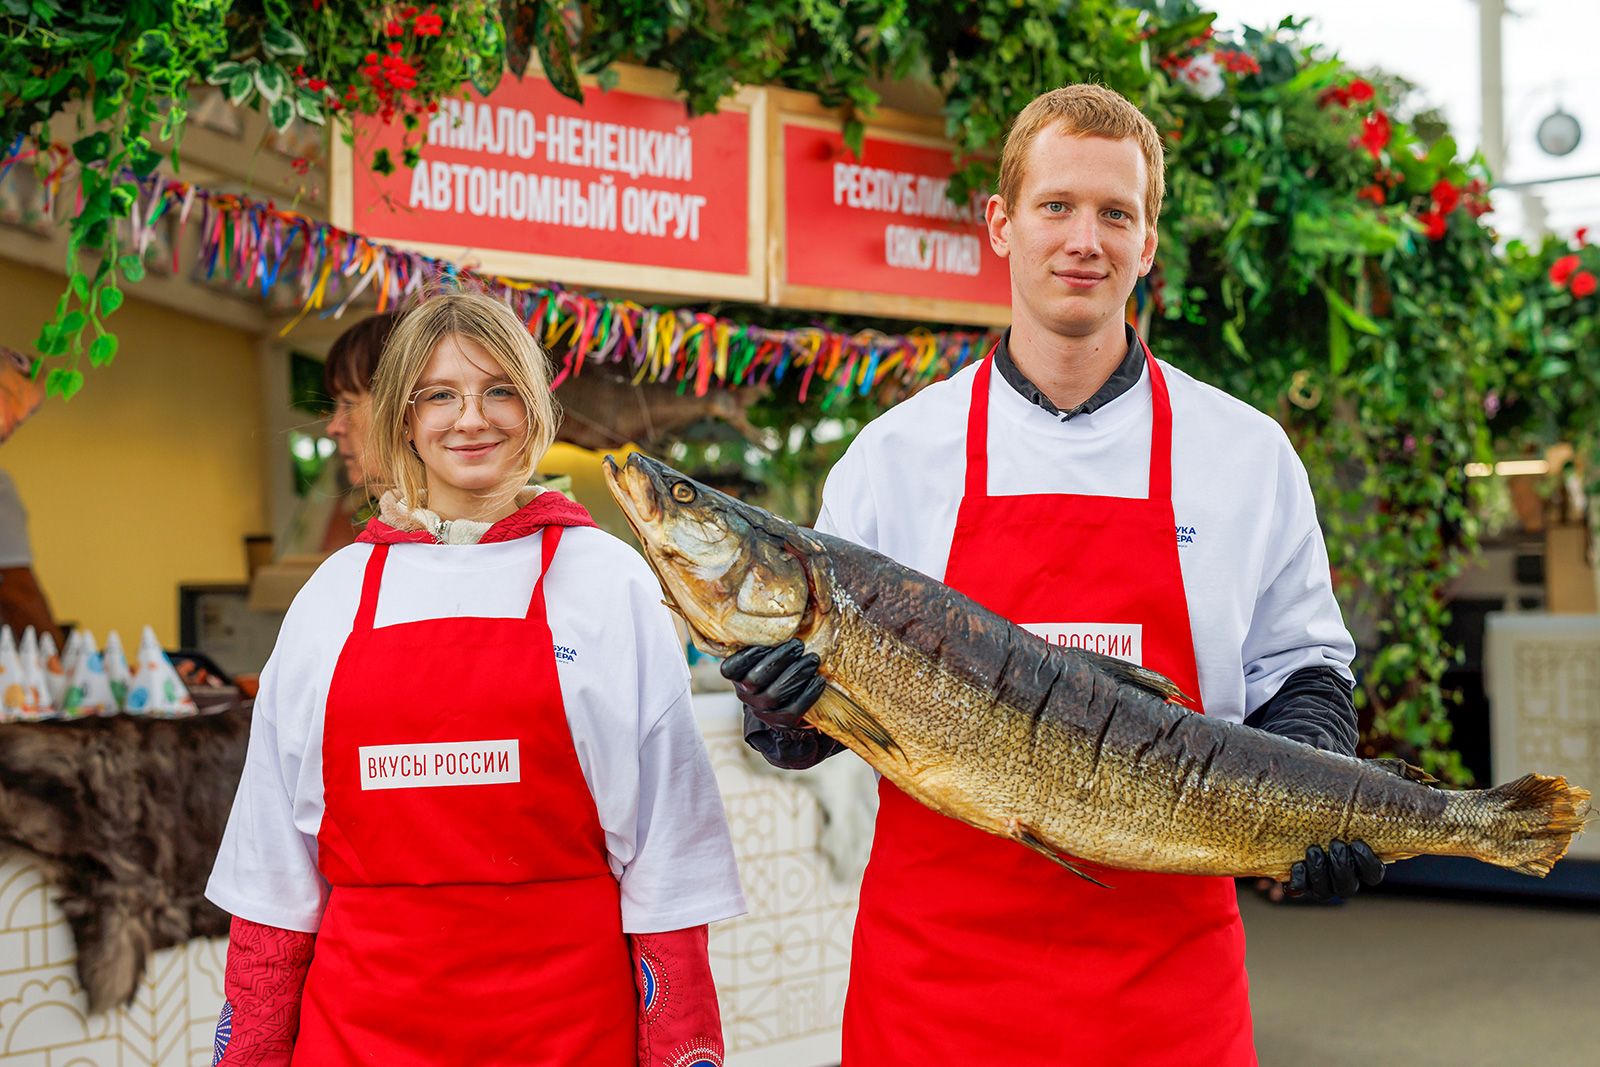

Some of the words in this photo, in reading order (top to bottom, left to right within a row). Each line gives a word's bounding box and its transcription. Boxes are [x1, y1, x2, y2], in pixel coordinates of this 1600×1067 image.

[409, 159, 617, 232] АВТОНОМНЫЙ
[622, 186, 706, 241] ОКРУГ
[555, 651, 575, 662] ЕРА
[368, 754, 427, 779] ВКУСЫ
[434, 750, 509, 776] РОССИИ
